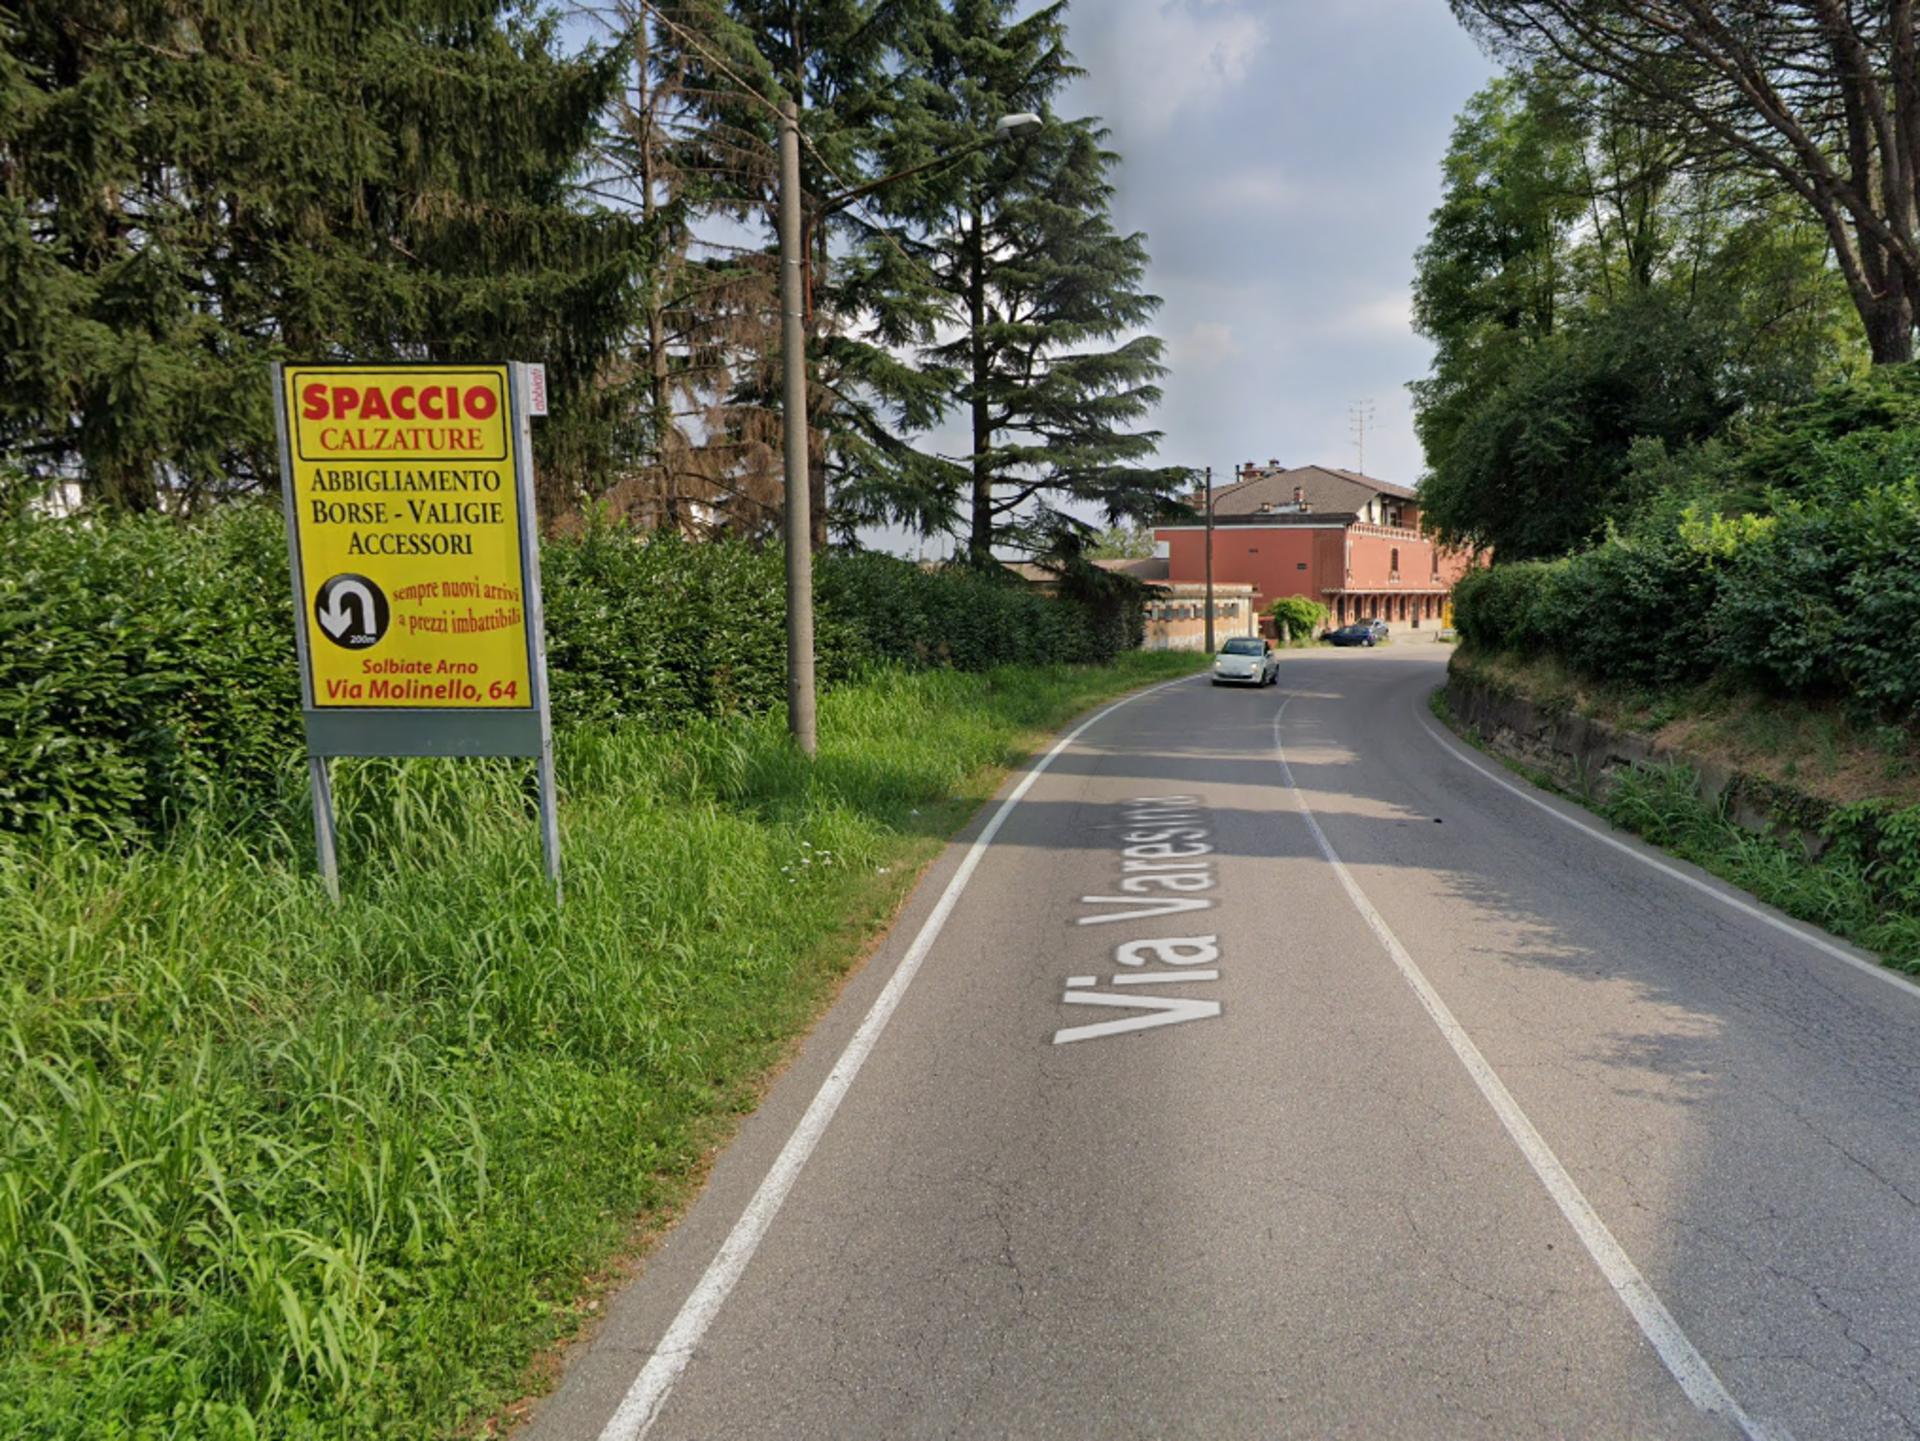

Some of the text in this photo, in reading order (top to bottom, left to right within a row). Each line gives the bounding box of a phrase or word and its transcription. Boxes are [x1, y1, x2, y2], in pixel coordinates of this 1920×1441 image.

[302, 383, 497, 421] SPACCIO
[320, 428, 484, 451] CALZATURE
[311, 468, 500, 492] ABBIGLIAMENTO
[312, 500, 388, 524] BORSE
[407, 500, 504, 524] VALIGIE
[348, 532, 473, 555] ACCESSORI
[392, 576, 519, 606] sempre nuovi arrivi
[398, 607, 521, 635] a prezzi imbattibili
[350, 634, 377, 644] 200m
[362, 658, 479, 675] Solbiate Arno
[326, 679, 518, 702] Via Molinello, 64
